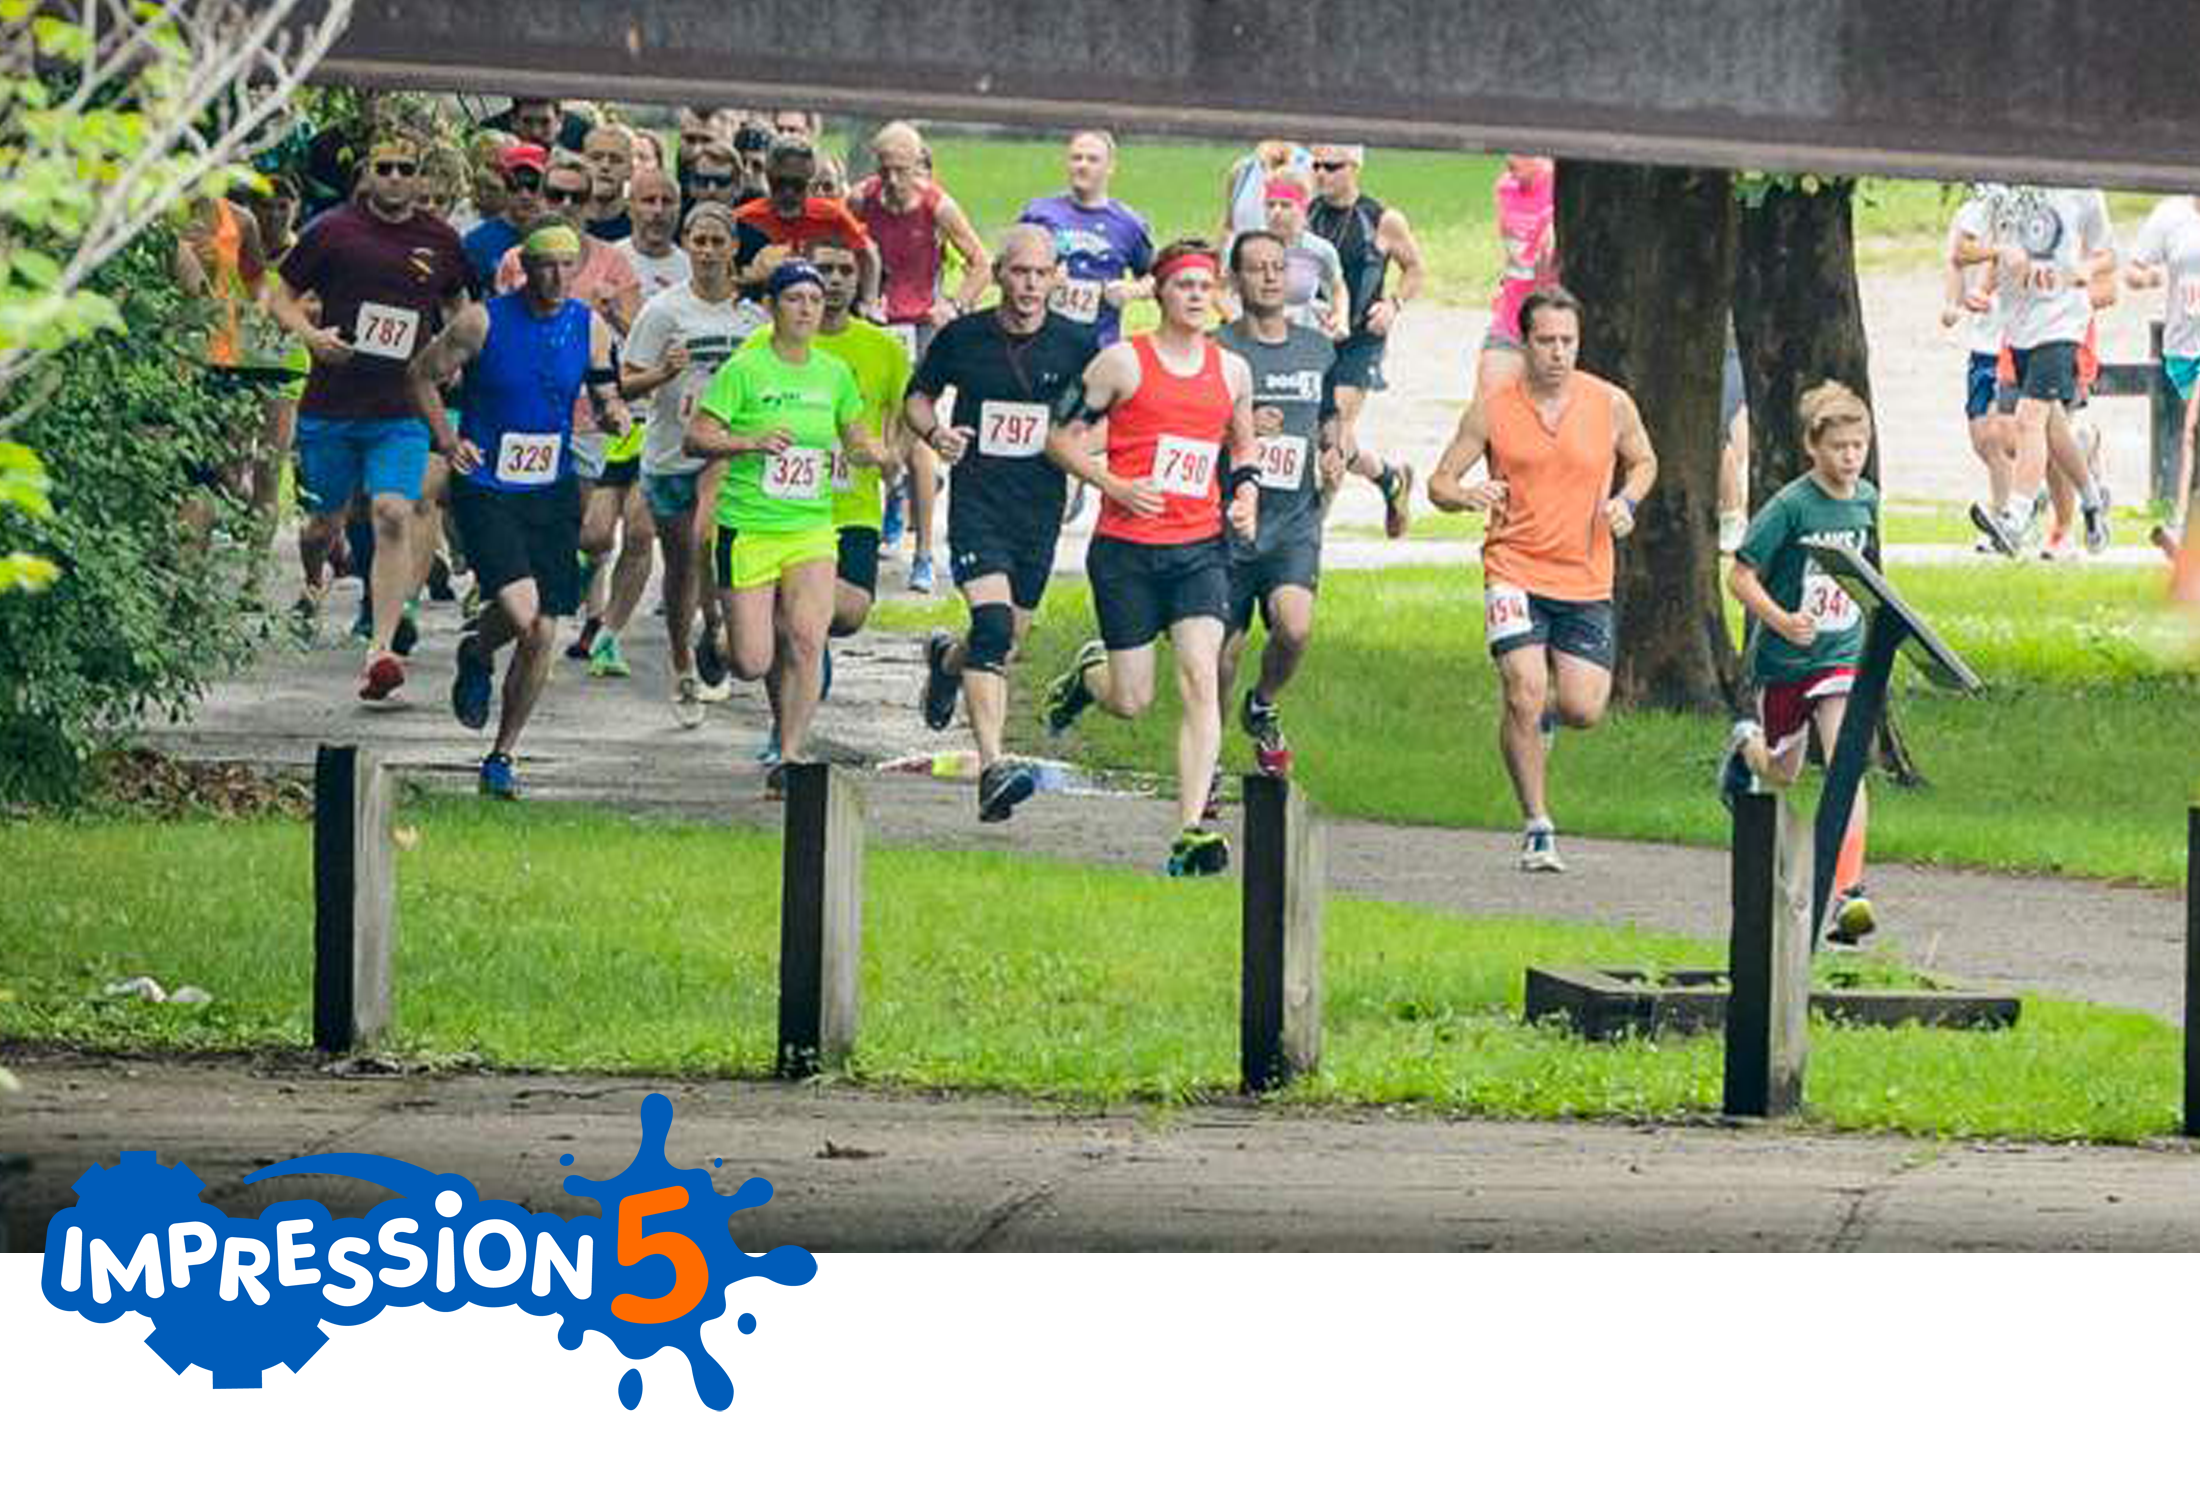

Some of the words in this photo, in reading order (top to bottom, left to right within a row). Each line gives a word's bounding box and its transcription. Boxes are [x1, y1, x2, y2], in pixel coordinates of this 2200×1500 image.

[365, 315, 409, 347] 787
[990, 414, 1038, 444] 797
[508, 444, 552, 473] 329
[773, 456, 813, 486] 325
[1811, 587, 1850, 617] 34
